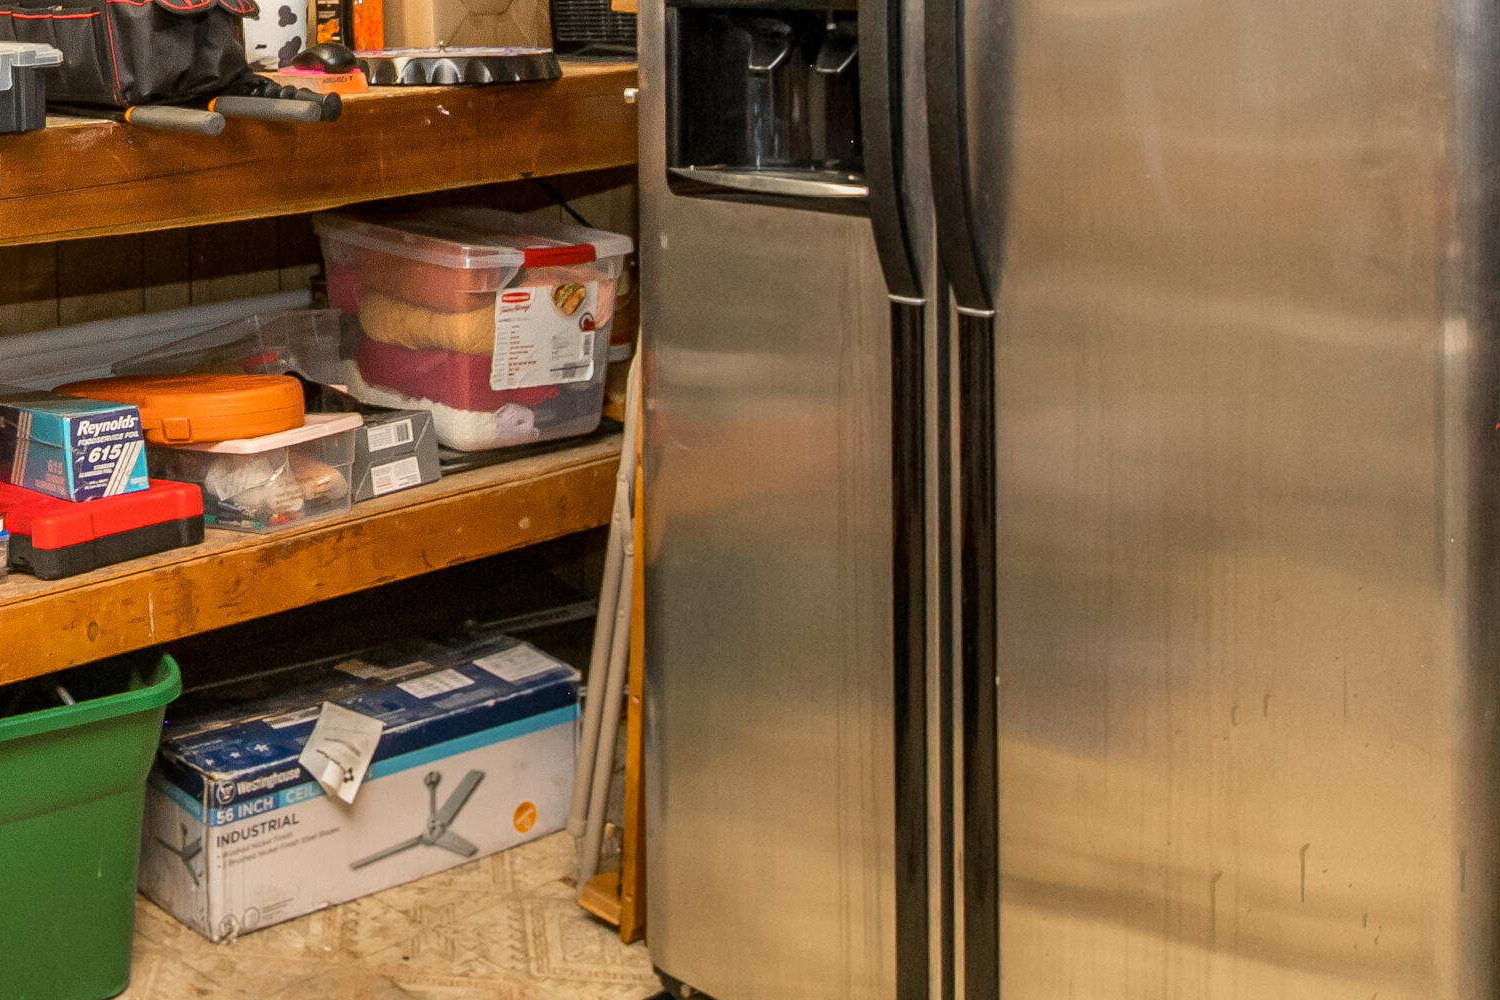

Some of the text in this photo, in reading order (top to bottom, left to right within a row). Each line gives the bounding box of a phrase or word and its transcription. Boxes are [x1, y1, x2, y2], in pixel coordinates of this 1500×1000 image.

[76, 414, 136, 437] Reynolds
[124, 430, 140, 439] FOIL
[88, 443, 123, 463] 615
[217, 780, 318, 824] 56 INCH CEIL
[216, 813, 300, 848] INDUSTRIAL
